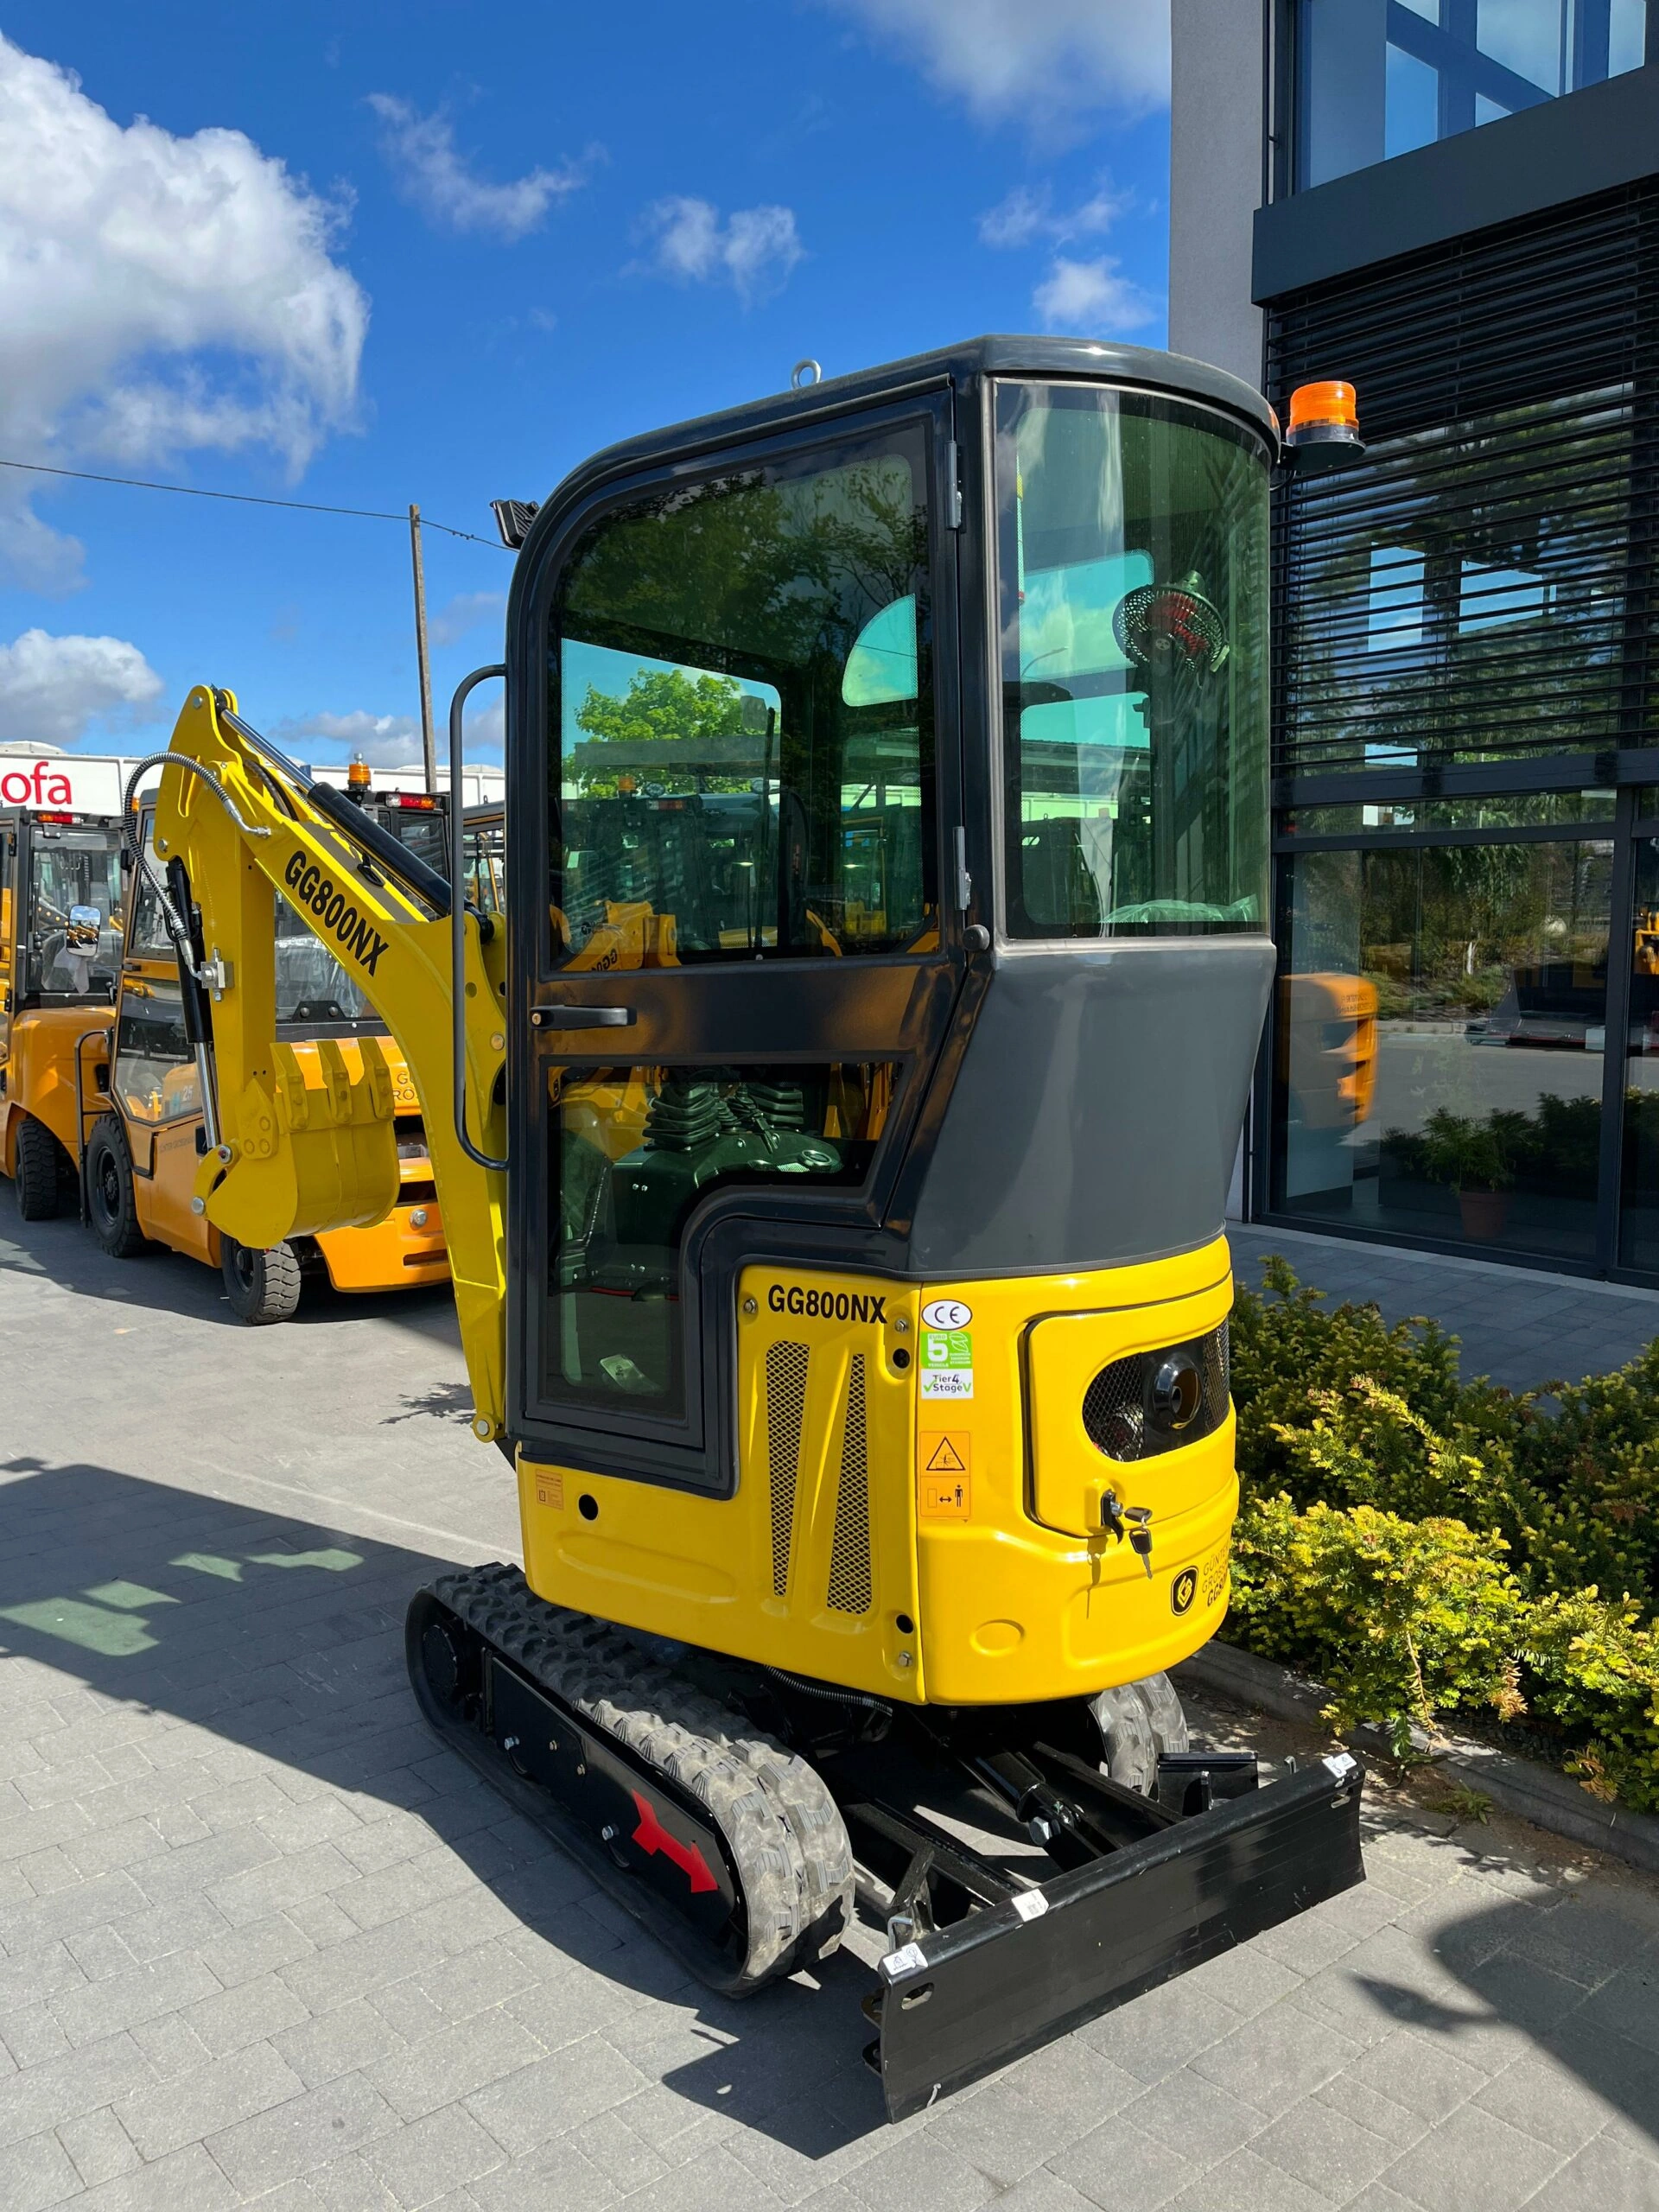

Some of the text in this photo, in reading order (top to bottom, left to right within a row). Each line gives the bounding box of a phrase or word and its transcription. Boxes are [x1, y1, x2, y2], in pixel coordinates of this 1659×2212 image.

[1, 761, 72, 804] ofa
[285, 850, 389, 977] GG800NX
[768, 1284, 887, 1324] GG800NX
[934, 1306, 960, 1324] CE
[933, 1383, 963, 1393] Stage
[952, 1374, 959, 1383] 4
